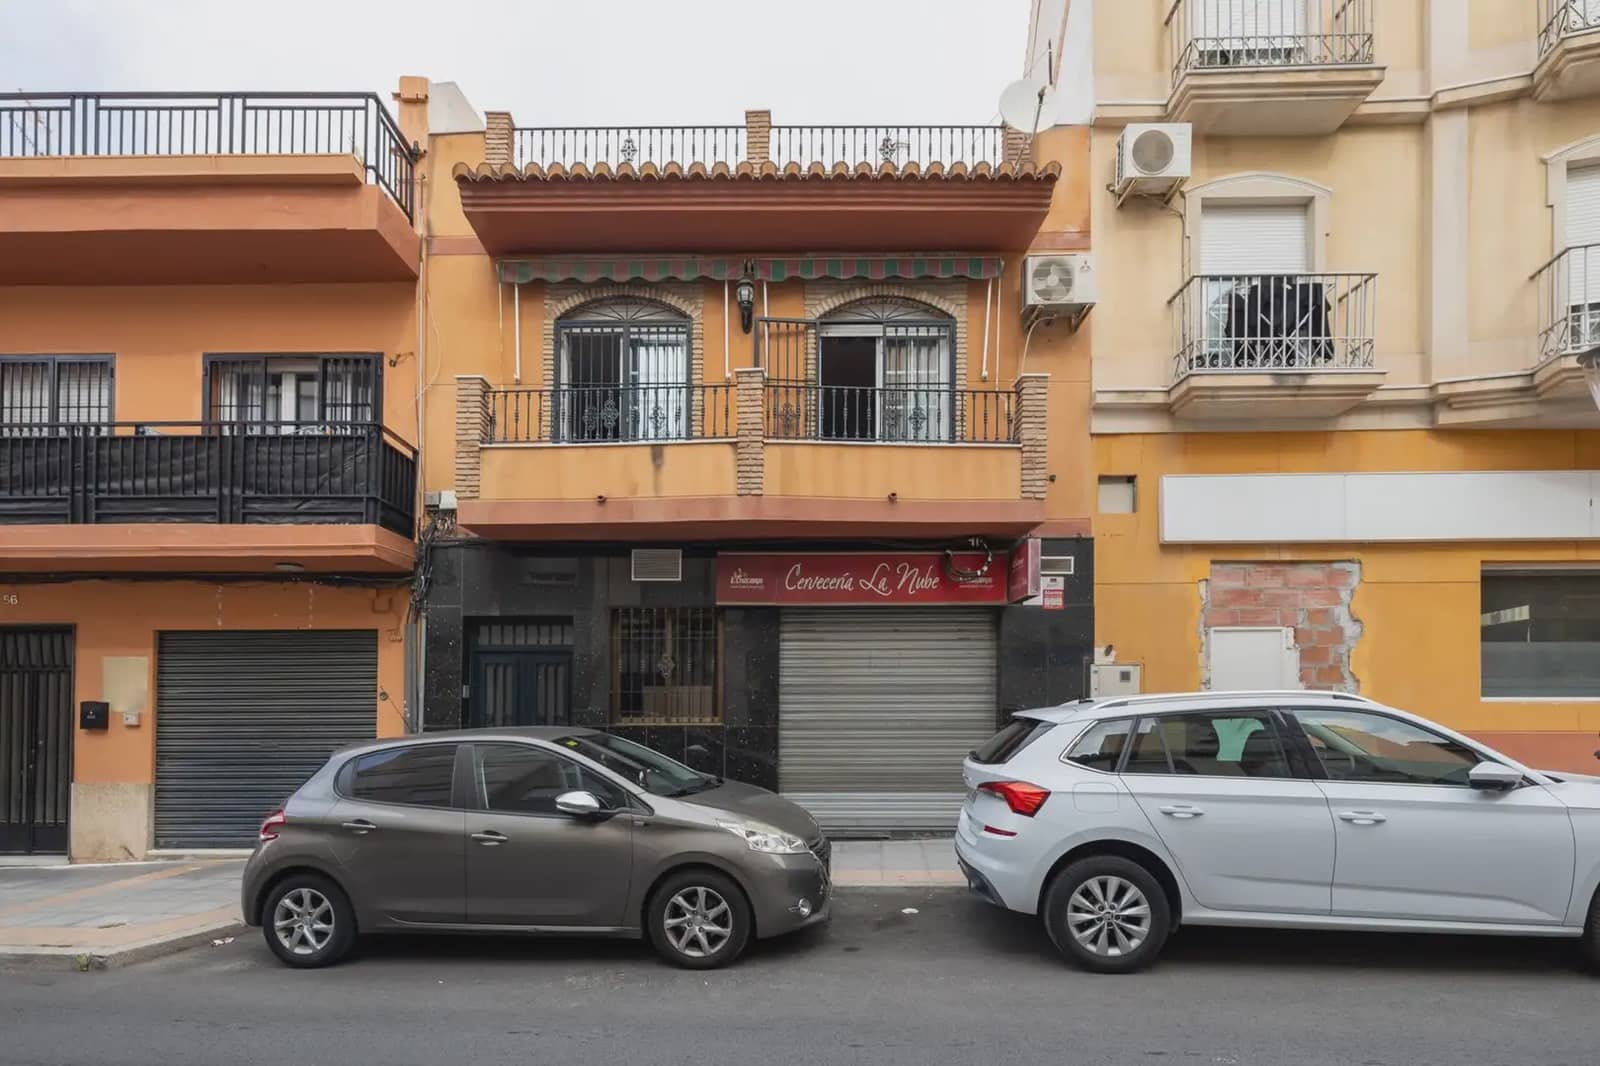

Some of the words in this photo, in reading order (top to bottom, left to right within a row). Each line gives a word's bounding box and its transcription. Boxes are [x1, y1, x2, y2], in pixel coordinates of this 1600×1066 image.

[785, 563, 854, 591] Cervecería
[859, 563, 892, 596] La
[897, 563, 940, 594] Nube
[3, 594, 18, 604] 56
